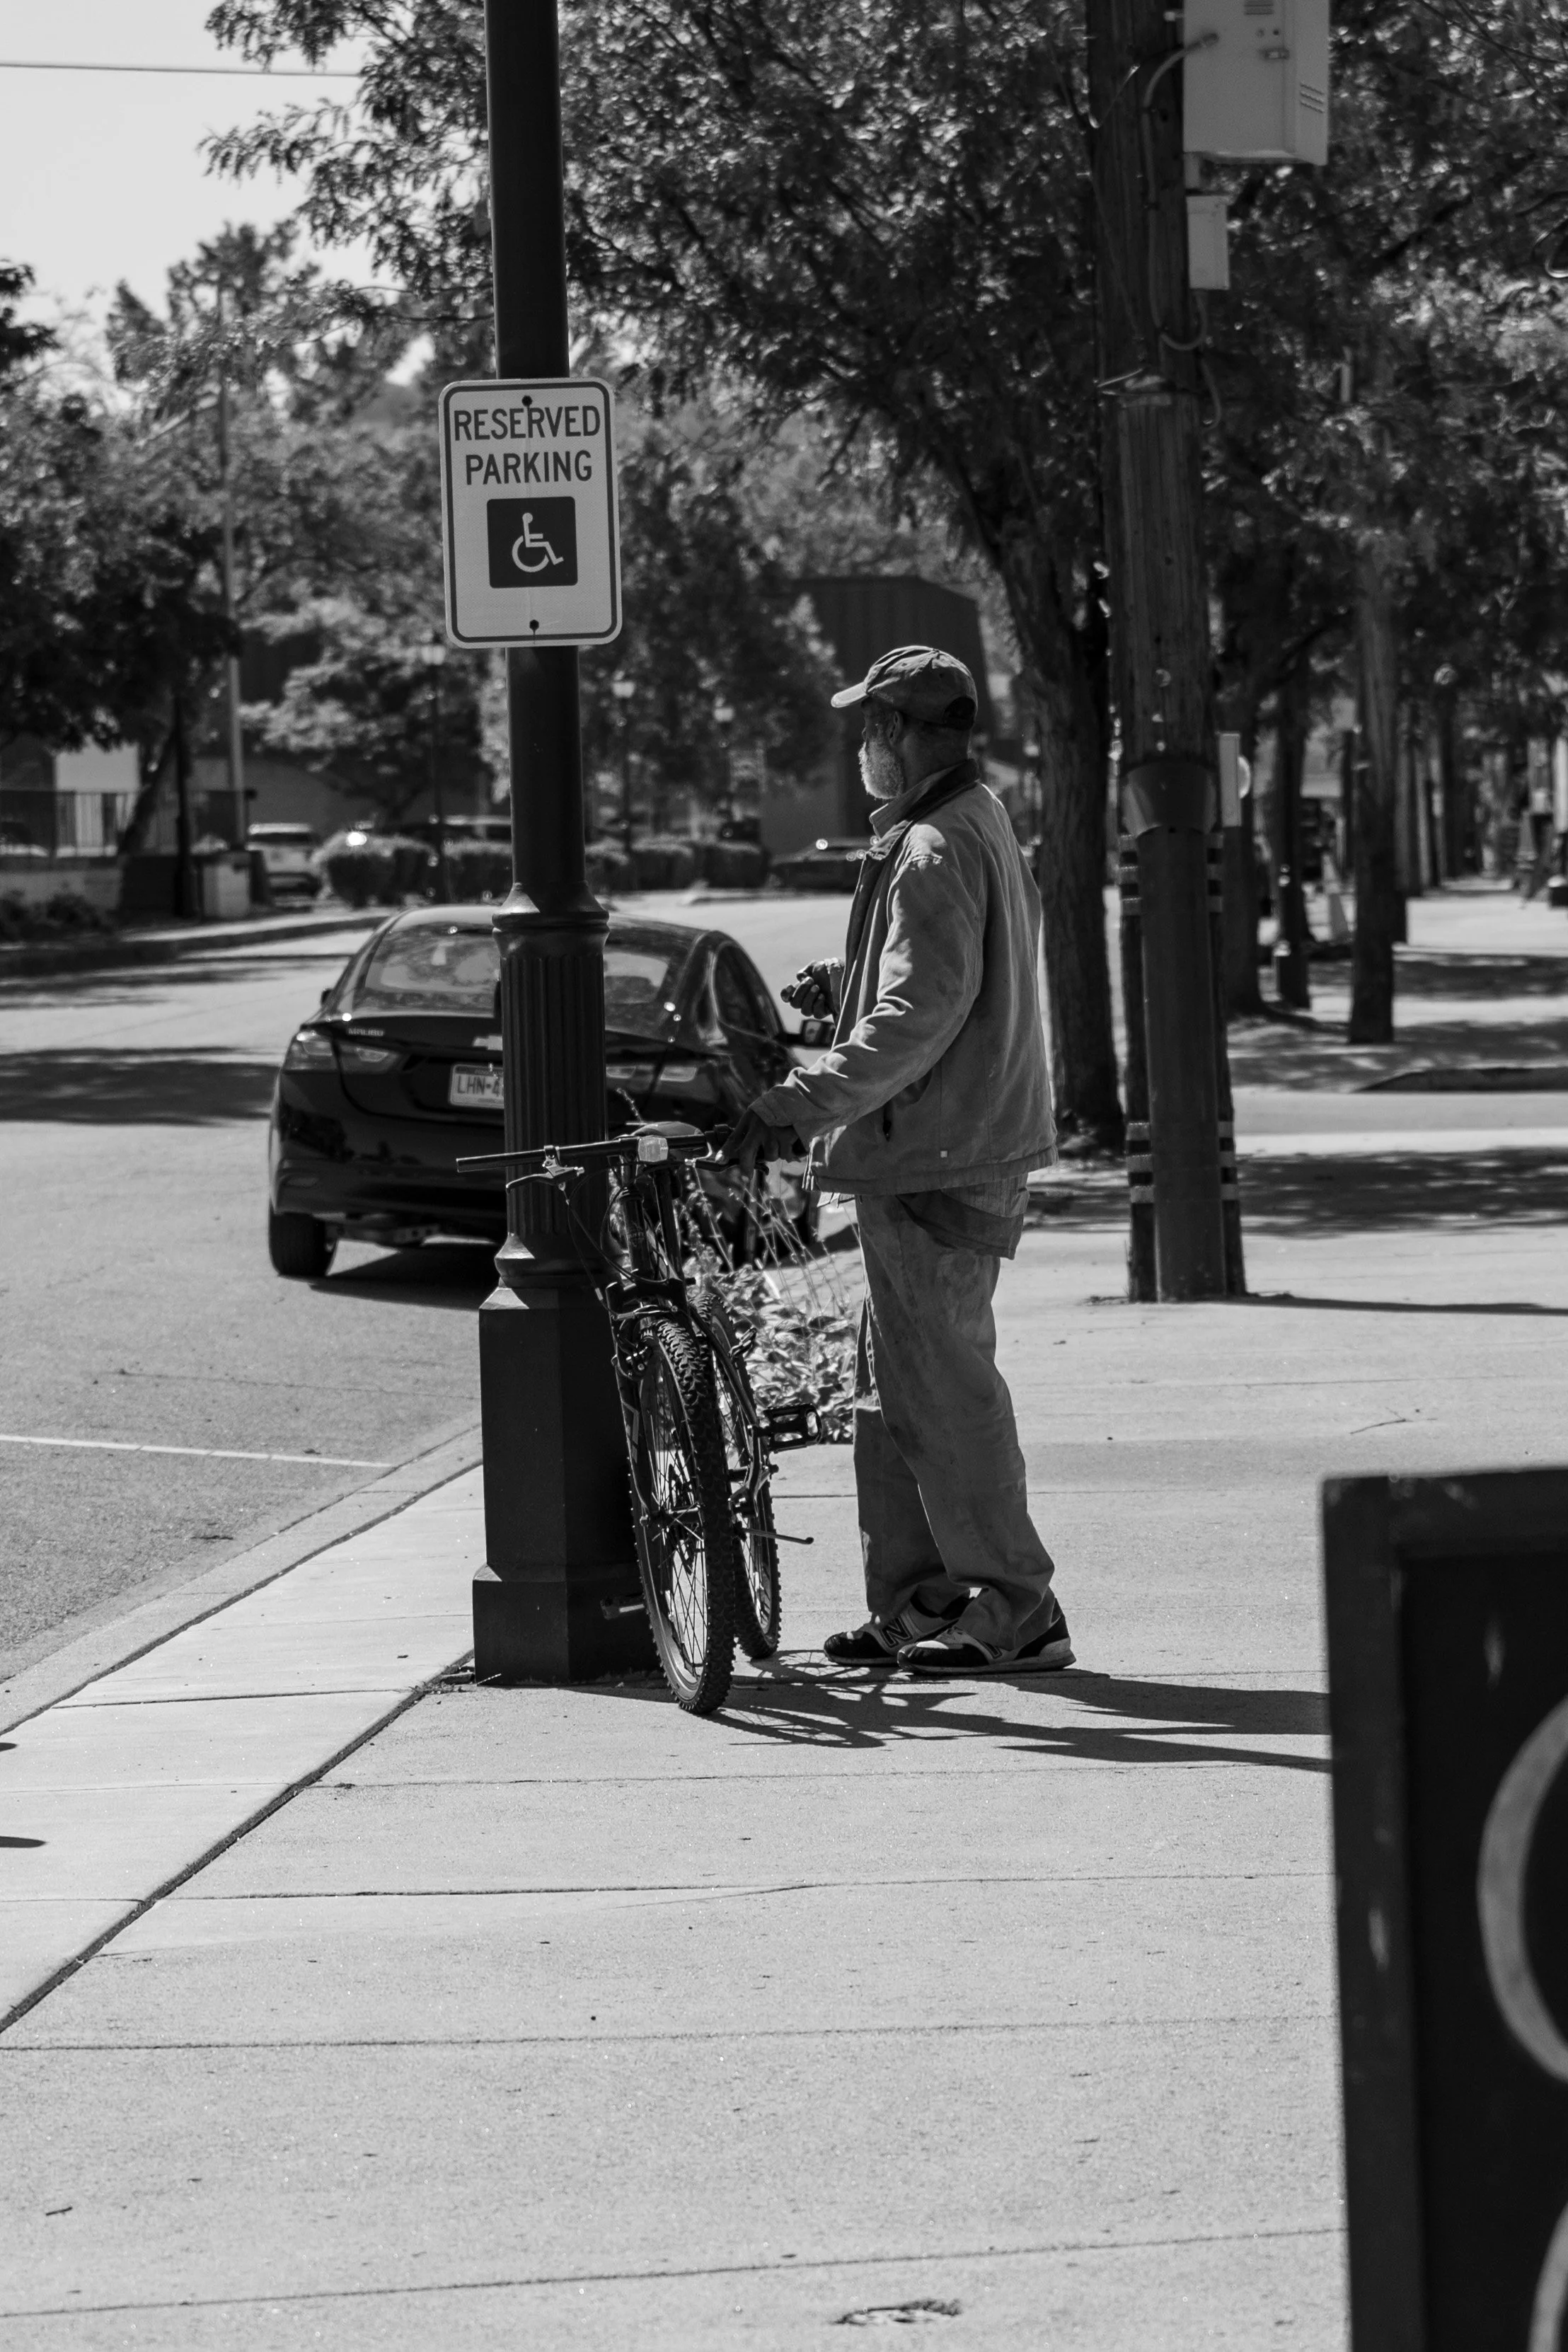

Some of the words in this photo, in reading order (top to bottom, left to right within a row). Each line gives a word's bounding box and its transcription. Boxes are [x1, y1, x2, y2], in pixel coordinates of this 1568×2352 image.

[454, 405, 601, 442] RESERVED
[465, 449, 593, 485] PARKING
[348, 1027, 384, 1037] MALIBU
[878, 1618, 913, 1648] N
